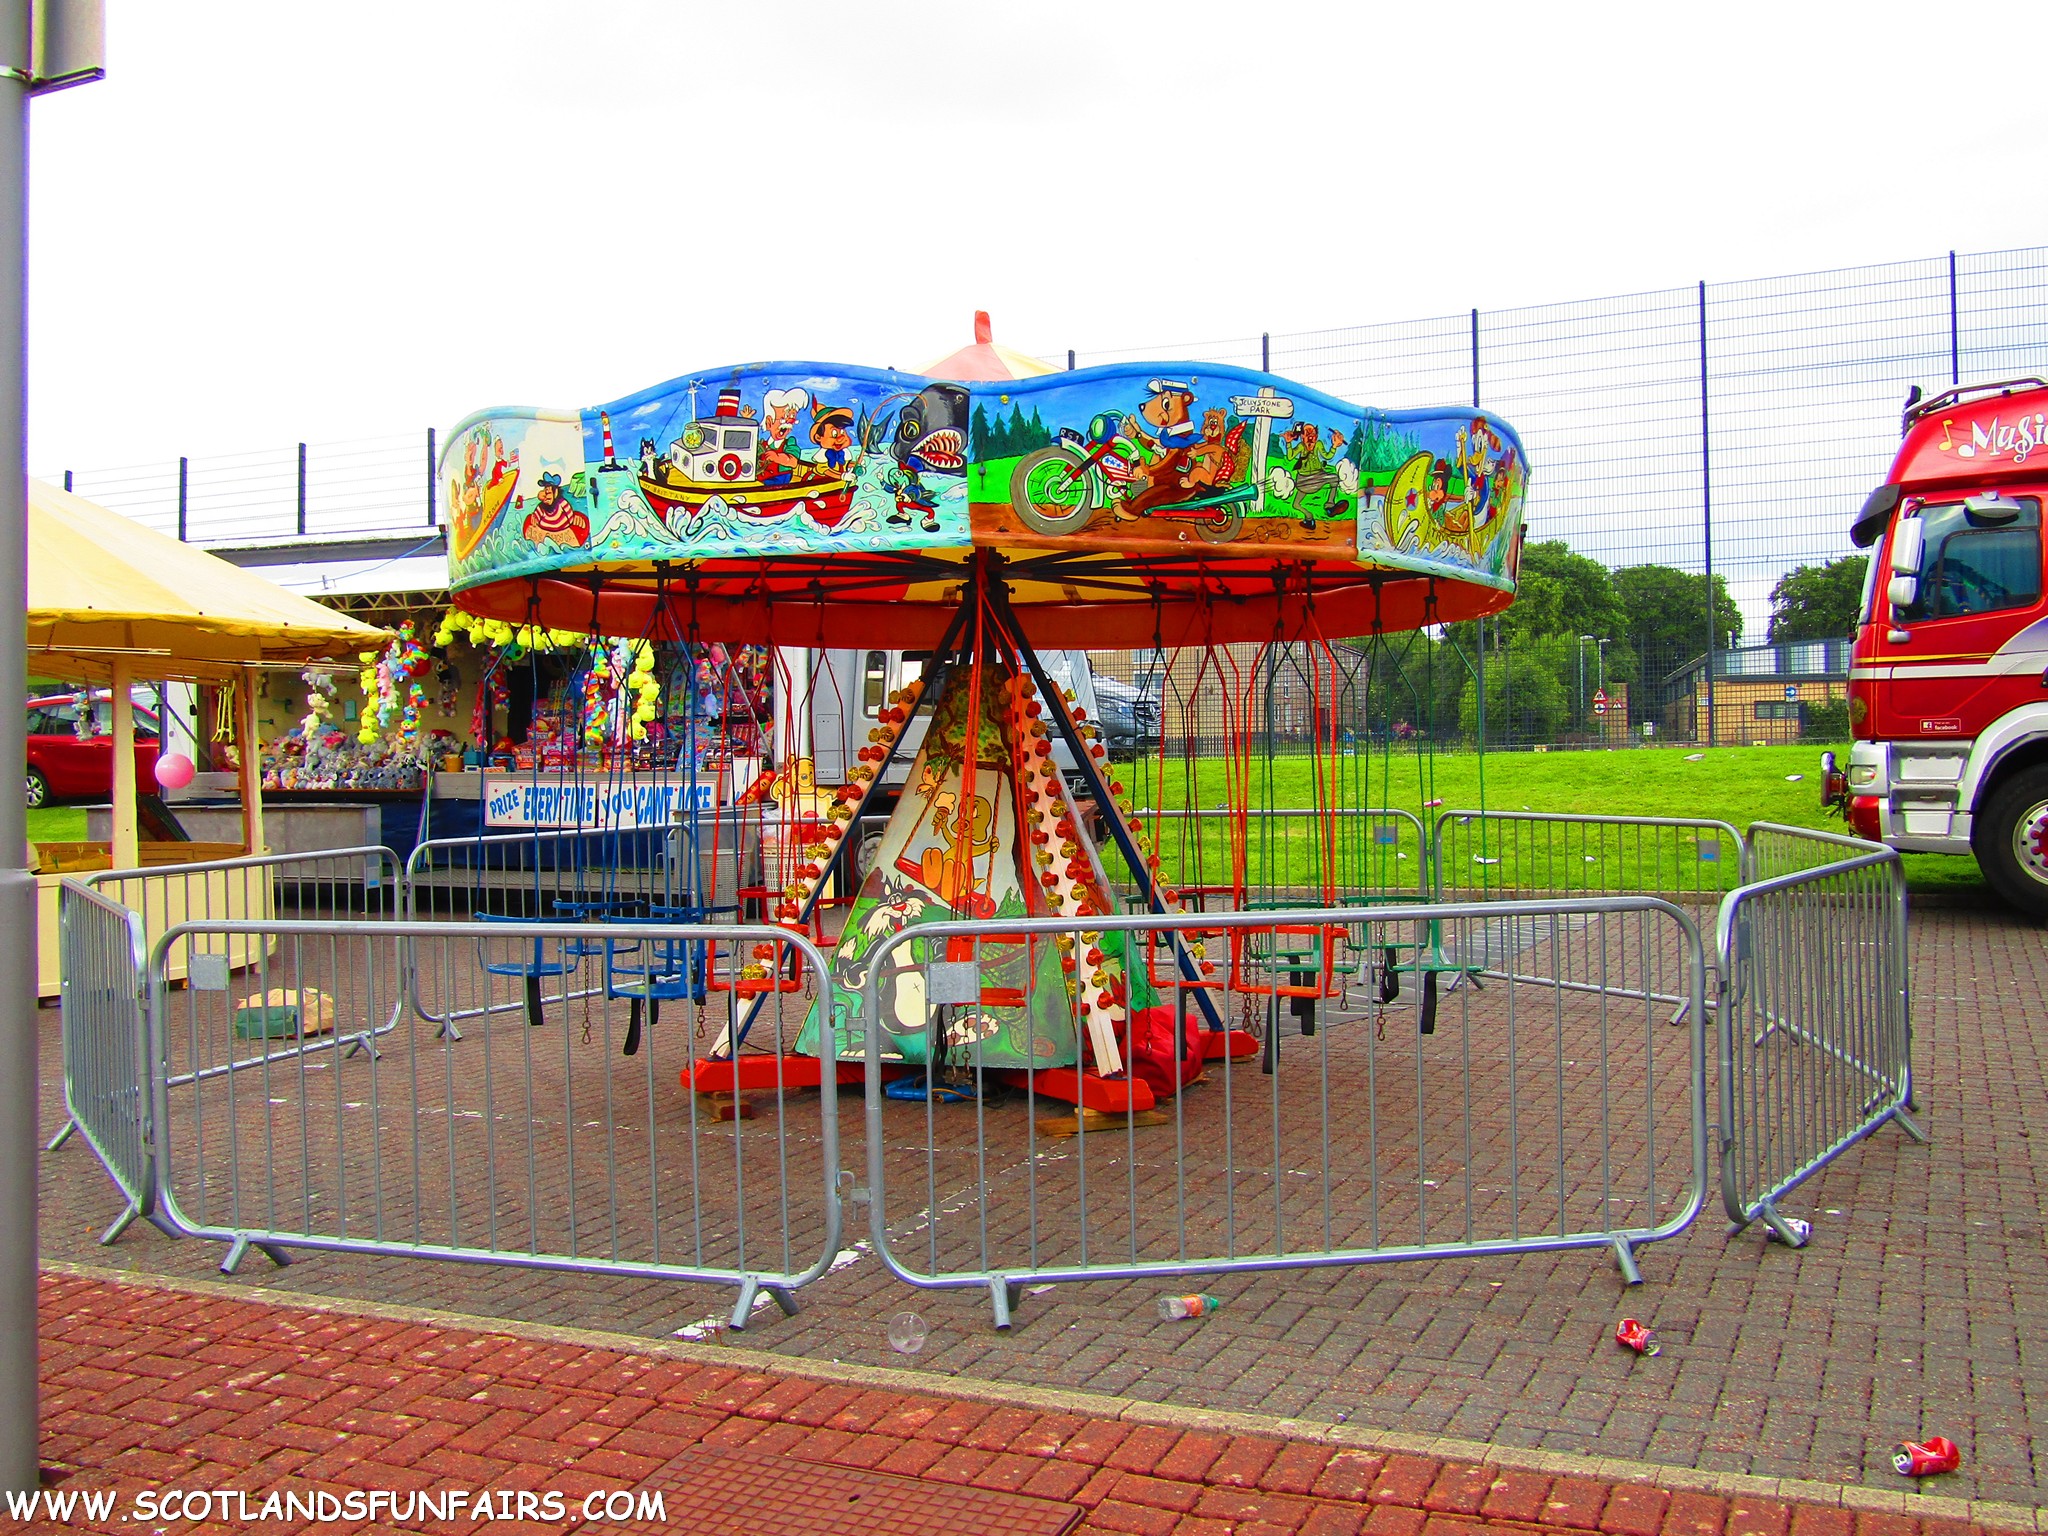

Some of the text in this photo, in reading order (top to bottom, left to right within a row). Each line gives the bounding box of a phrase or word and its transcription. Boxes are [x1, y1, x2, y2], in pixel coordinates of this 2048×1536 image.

[1238, 398, 1281, 408] JELLYSTONE
[1250, 406, 1271, 414] PARK
[489, 786, 594, 824] PRIZE EVERY TIME
[601, 787, 633, 819] YOU
